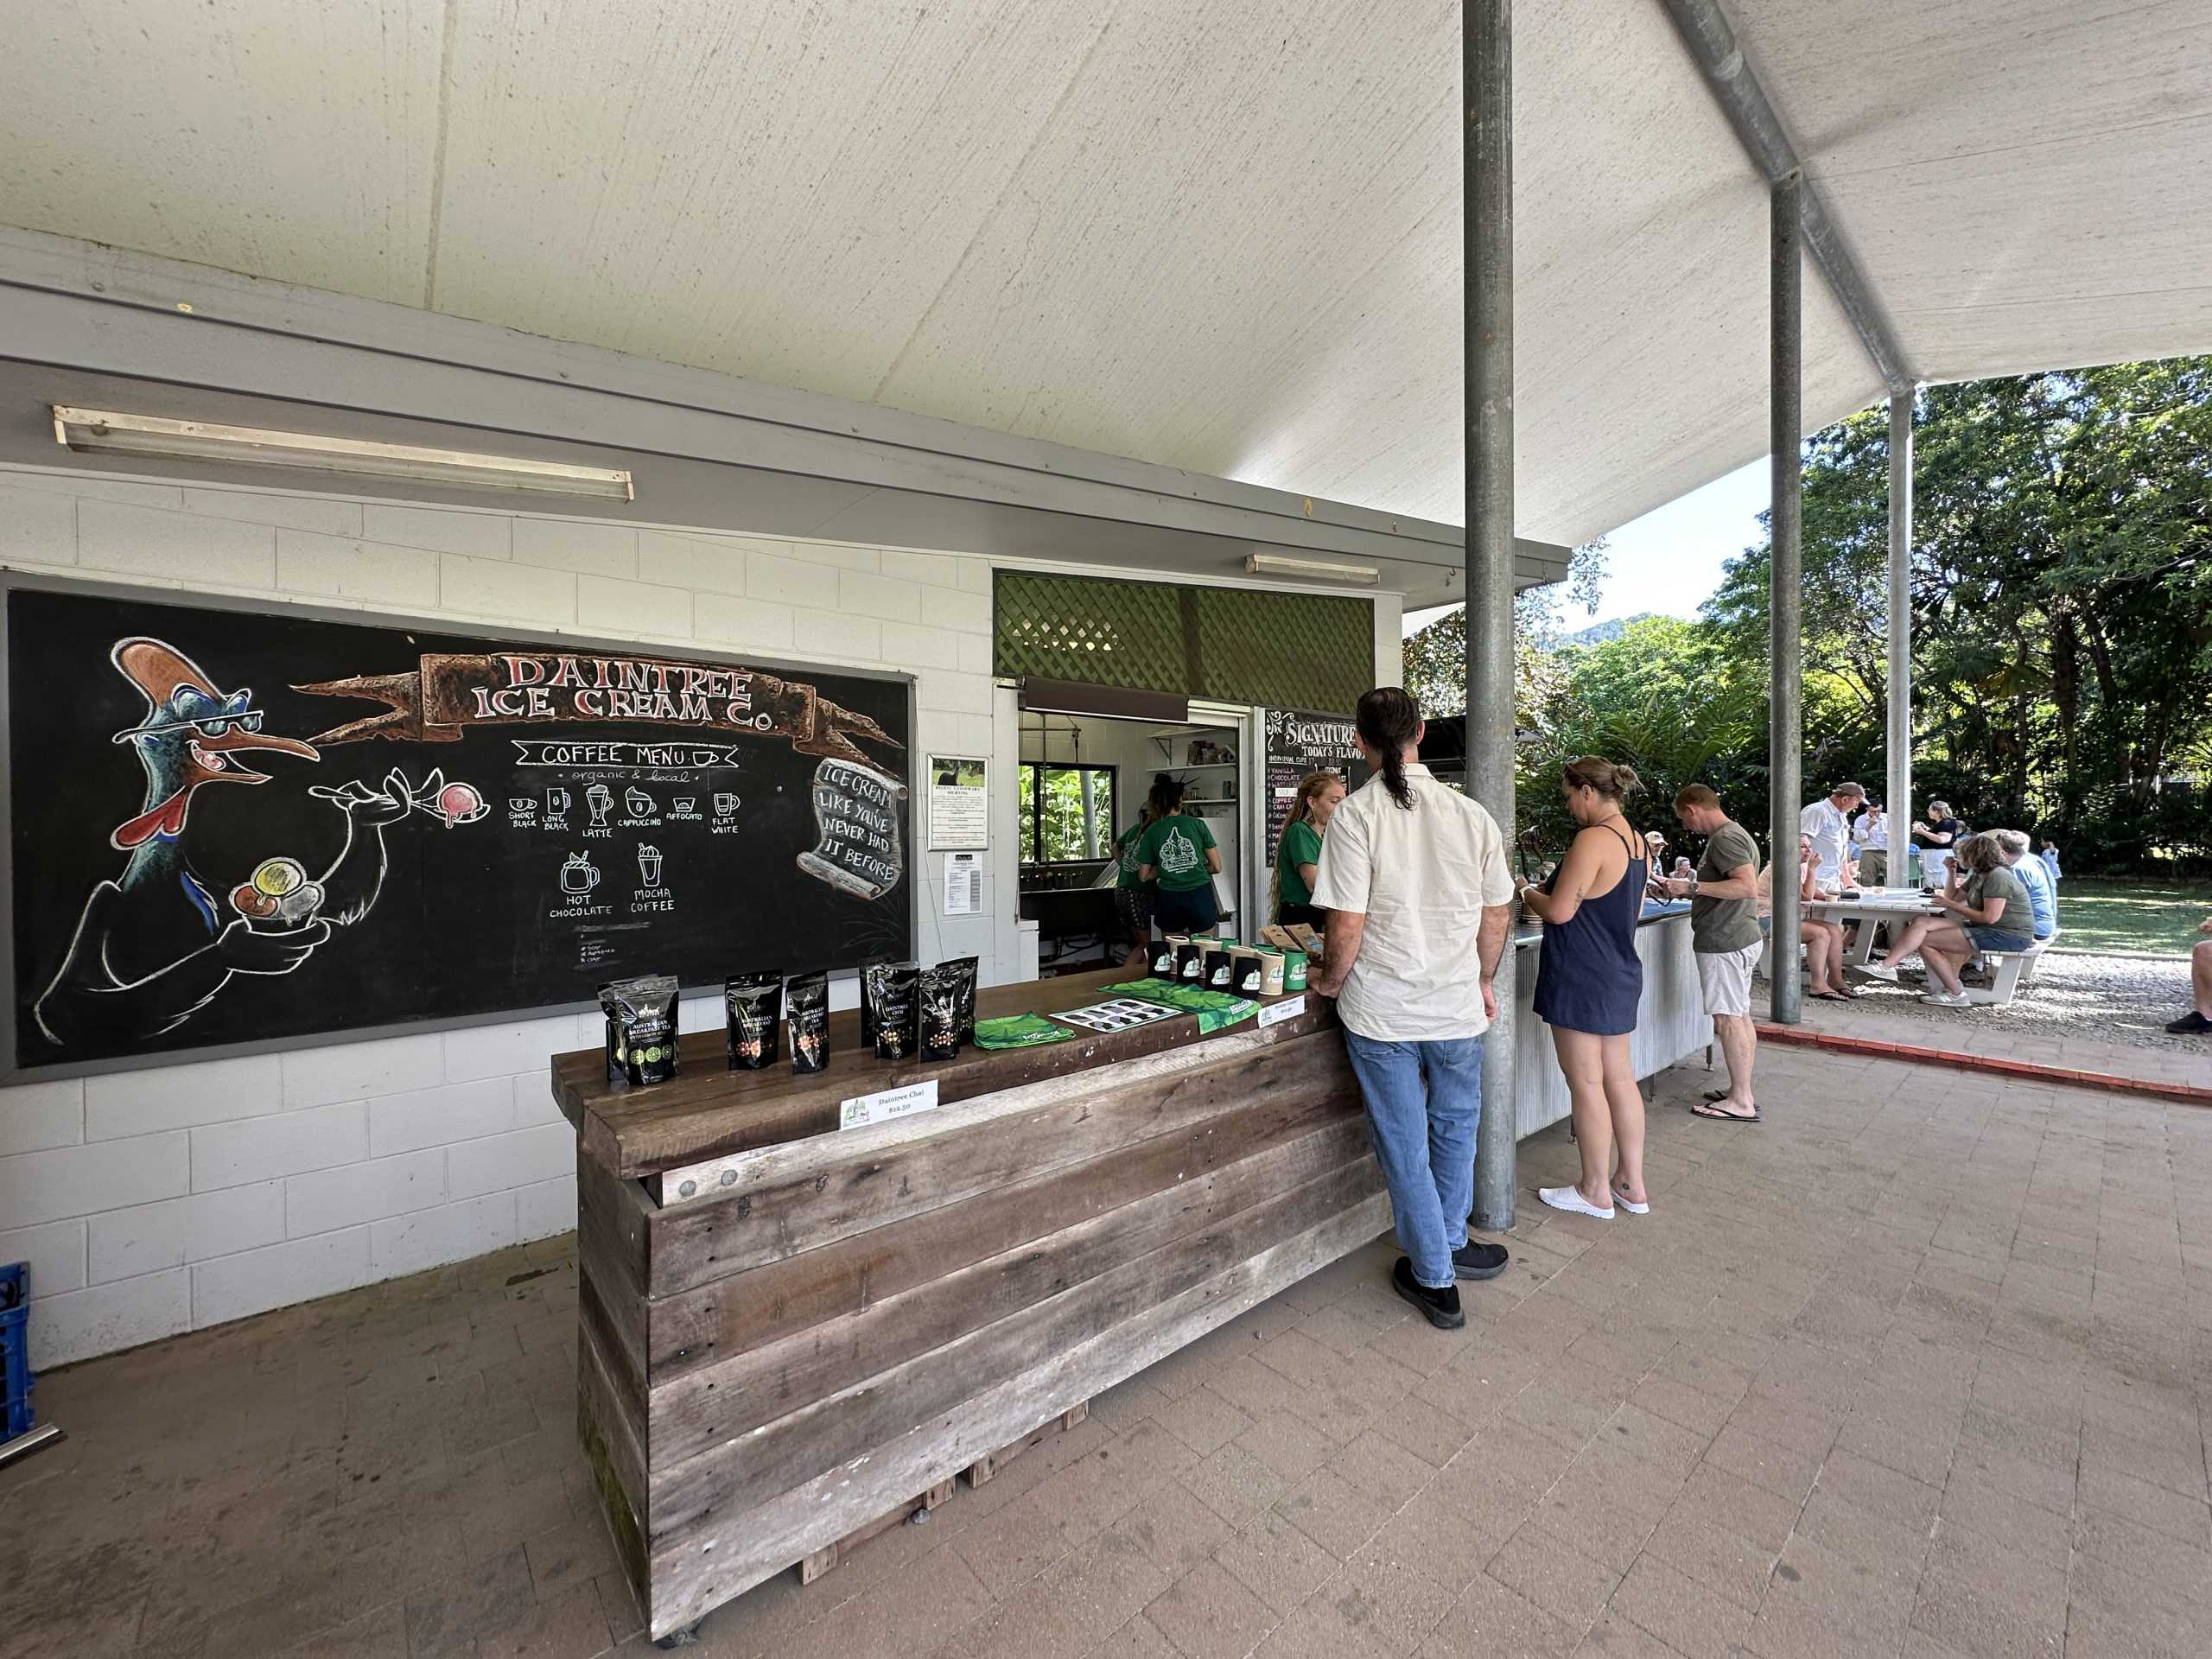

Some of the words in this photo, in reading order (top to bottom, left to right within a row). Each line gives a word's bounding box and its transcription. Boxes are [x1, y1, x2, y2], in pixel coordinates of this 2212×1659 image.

[500, 656, 754, 701] DAINTREE
[471, 687, 555, 720] ICE
[575, 690, 713, 721] CREAM
[541, 745, 622, 765] COFFEE
[636, 746, 684, 766] MENU
[1302, 746, 1333, 758] TODAY'S
[570, 771, 626, 785] organic
[632, 770, 639, 779] &
[645, 770, 690, 783] local
[823, 764, 853, 787] ICE
[851, 775, 893, 809] CREAM
[508, 811, 535, 820] SHORT
[666, 812, 702, 821] AFFOGATO
[819, 791, 854, 814] LIKE
[855, 804, 888, 832] YOU'VE
[512, 819, 537, 828] BLACK
[544, 822, 569, 831] BLACK
[618, 818, 662, 827] CAPPUCCINO
[712, 817, 735, 826] FLAT
[582, 828, 613, 838] LATTE
[711, 825, 739, 835] WHITE
[824, 817, 865, 842] NEVER
[868, 832, 890, 852] HAD
[824, 838, 844, 856] IT
[844, 848, 894, 880] BEFORE
[566, 894, 592, 906] HOT
[634, 887, 671, 901] MOCHA
[550, 906, 614, 918] CHOCOLATE
[631, 899, 676, 913] COFFEE
[629, 1027, 660, 1036] BREAKFAST
[878, 1092, 908, 1107] Daintree
[909, 1089, 925, 1099] Chai
